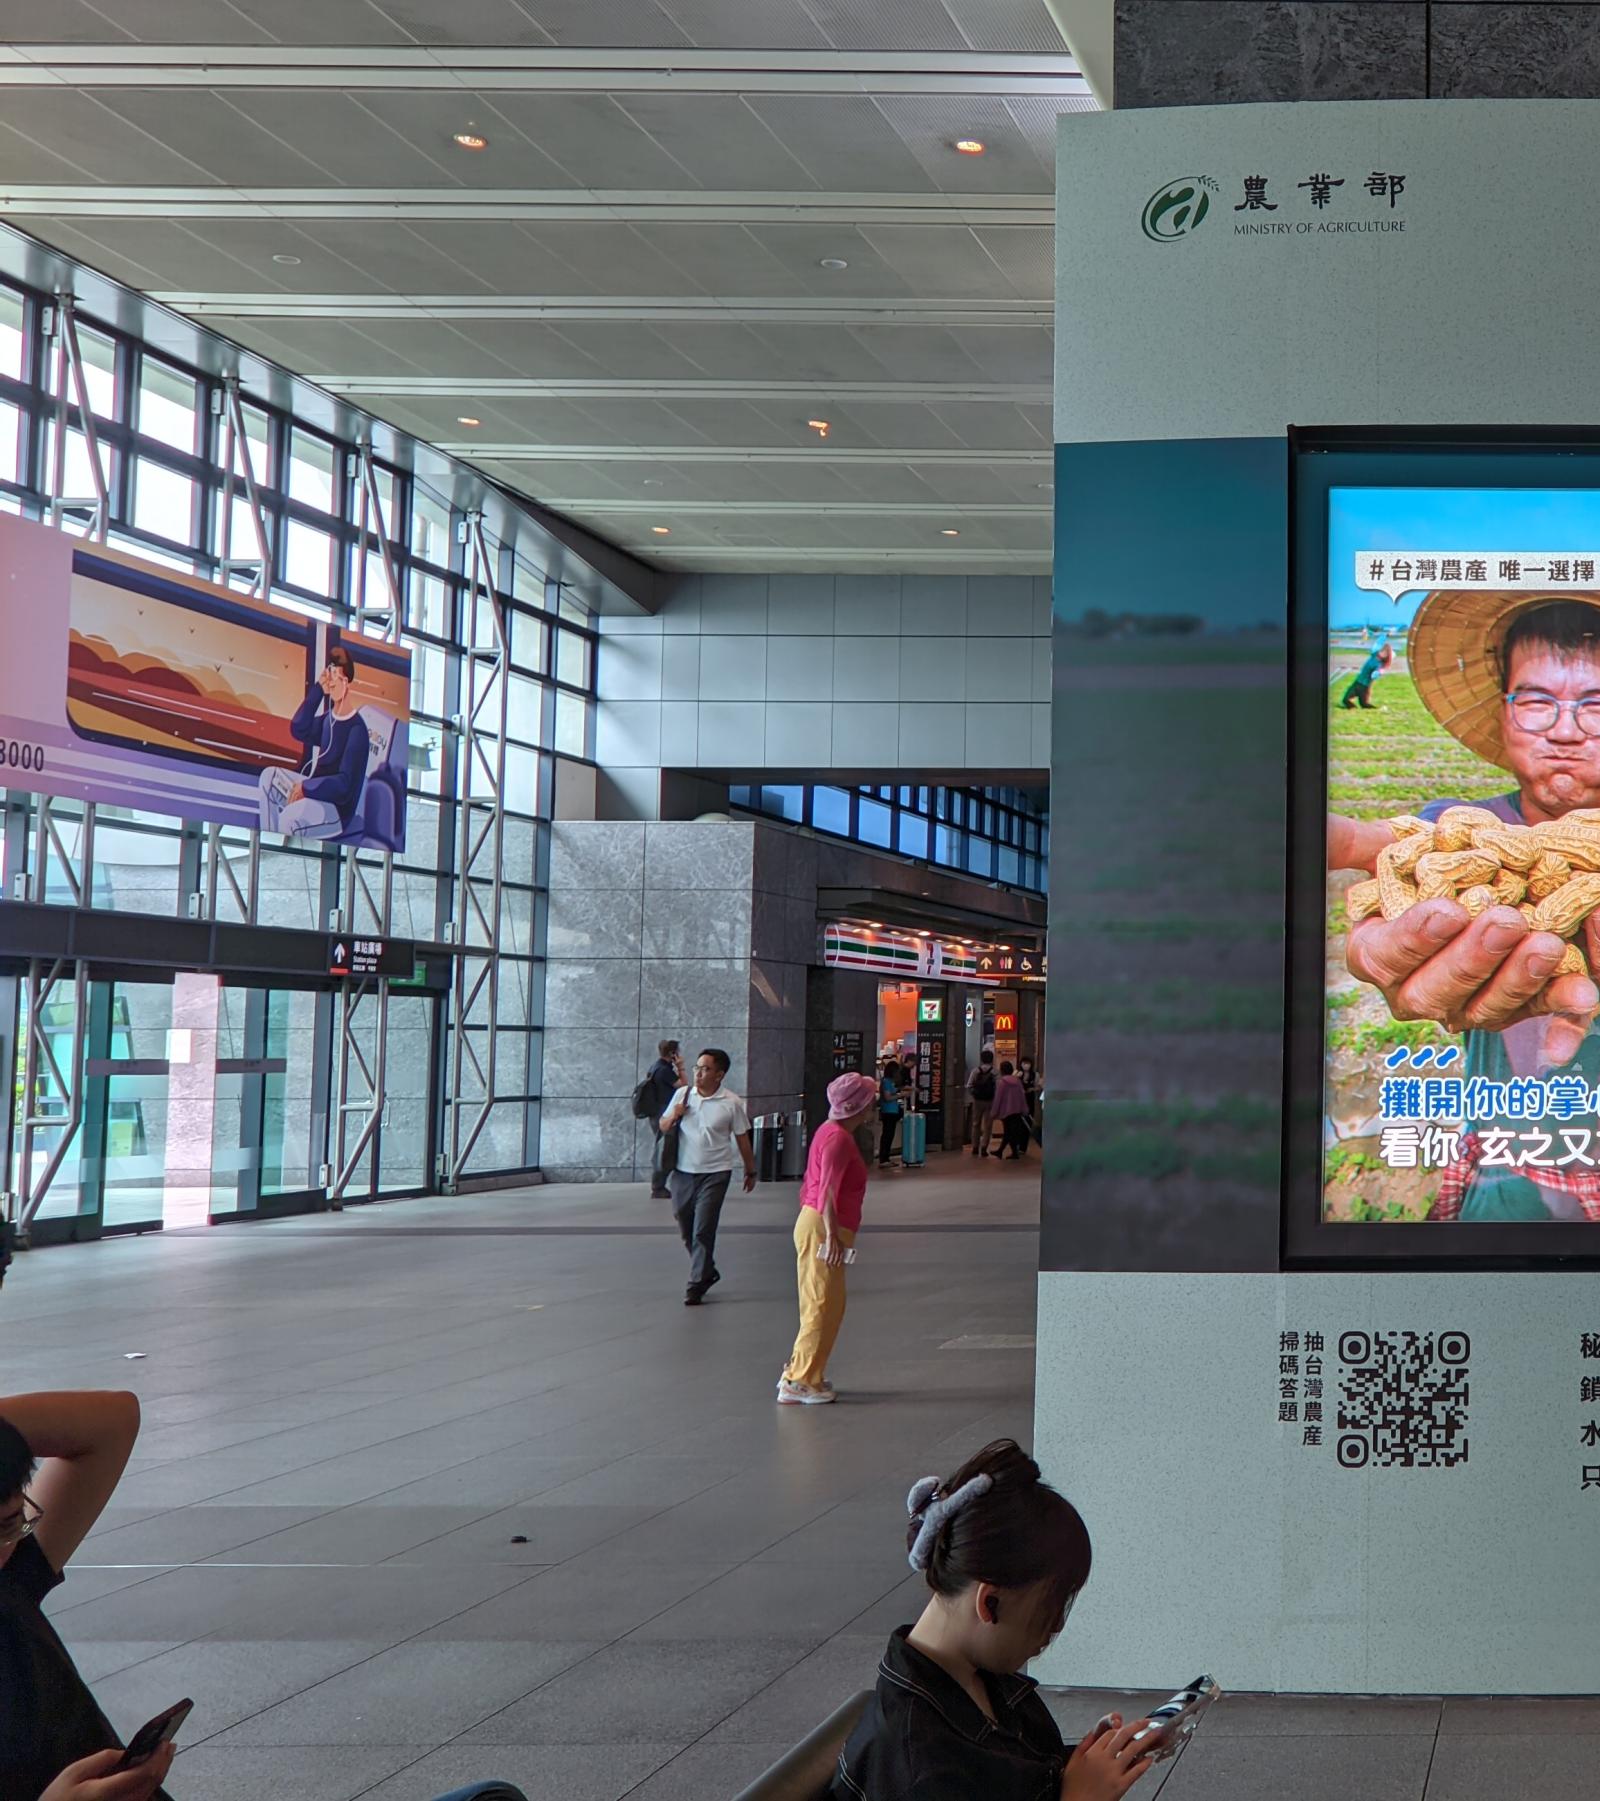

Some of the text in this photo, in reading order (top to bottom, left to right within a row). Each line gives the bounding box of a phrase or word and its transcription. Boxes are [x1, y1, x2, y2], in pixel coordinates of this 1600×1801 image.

[1234, 171, 1407, 211] 農業部
[1234, 220, 1407, 236] MINISTRY OF AGRICULTURE
[1369, 558, 1596, 582] #台灣農產 唯一選擇
[1379, 1125, 1460, 1169] 看你
[1278, 1330, 1300, 1422] 掃碼答題
[1302, 1330, 1324, 1446] 抽台灣農產
